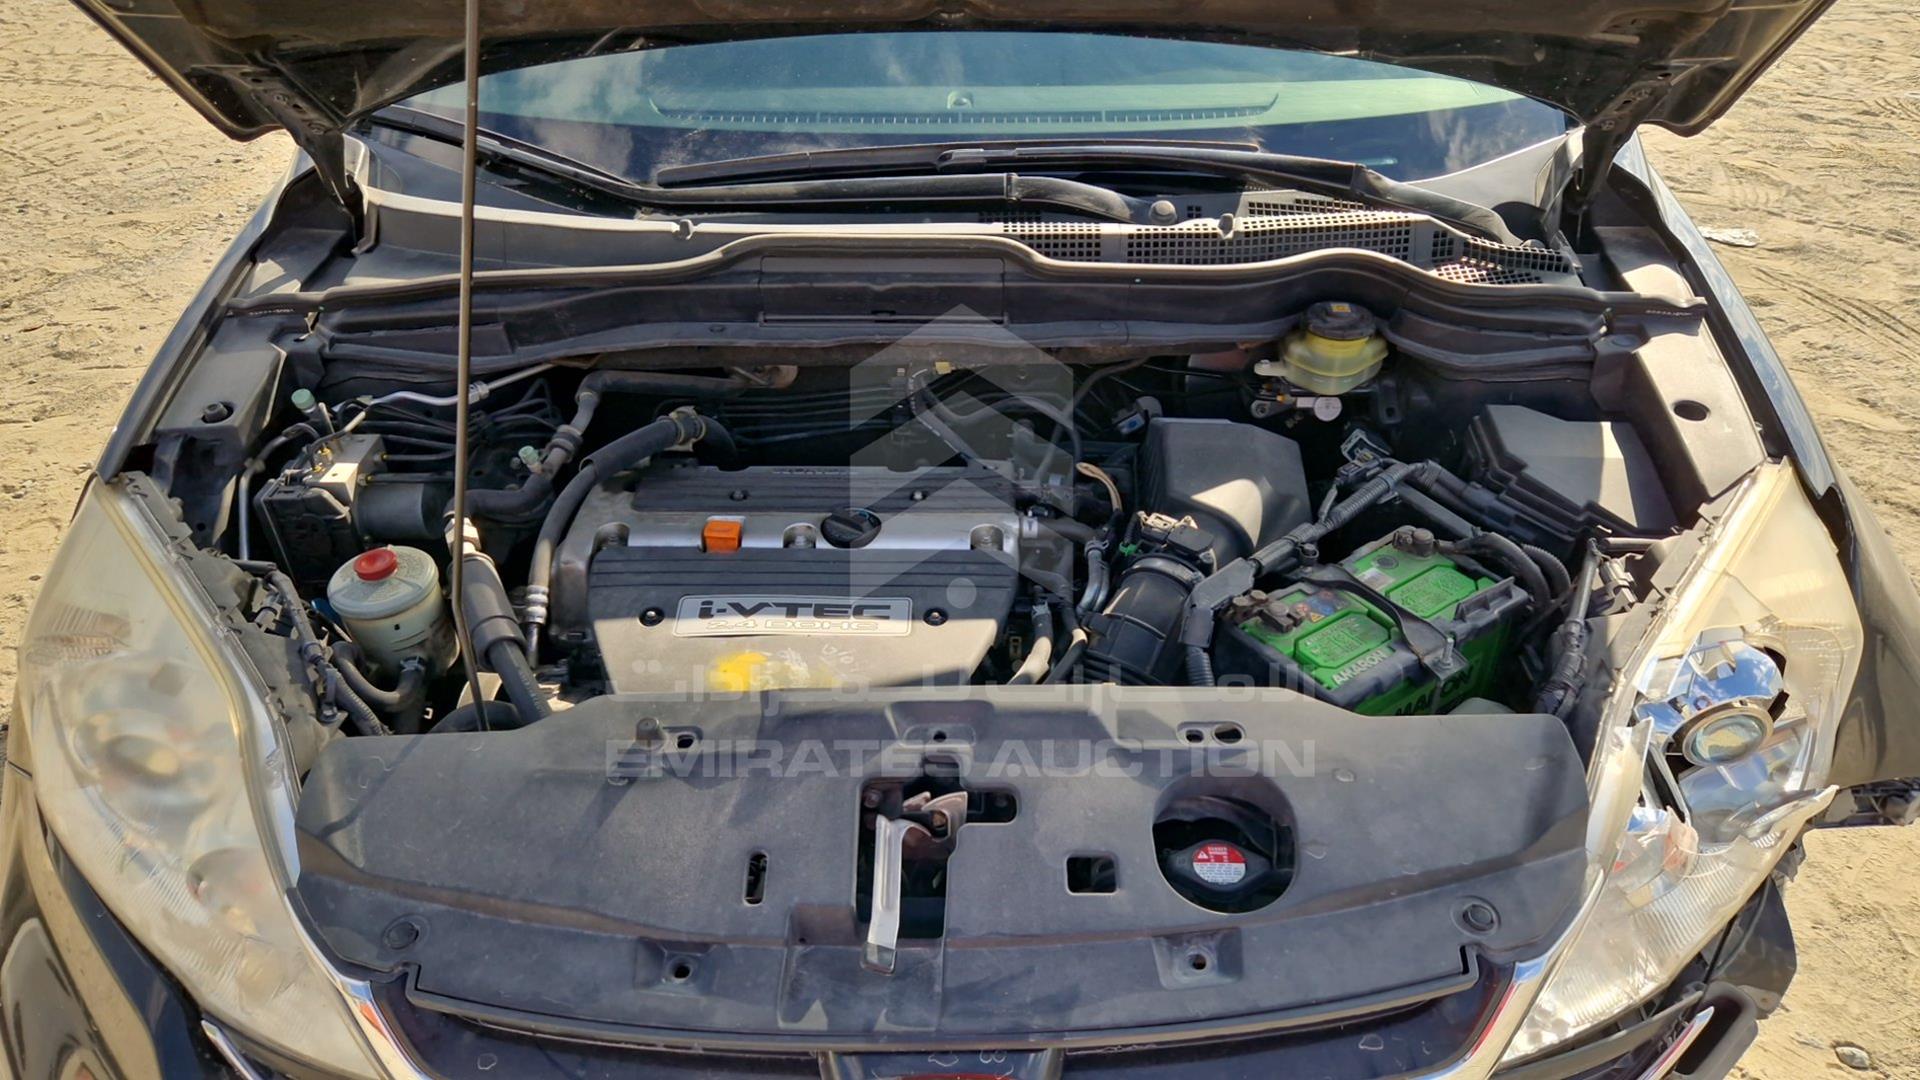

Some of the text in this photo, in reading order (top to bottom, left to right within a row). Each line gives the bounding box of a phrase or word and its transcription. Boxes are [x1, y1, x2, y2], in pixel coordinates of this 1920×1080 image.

[698, 600, 892, 620] i-VTEC
[706, 619, 878, 631] 2.4 DOHC
[1332, 648, 1388, 685] AMARON
